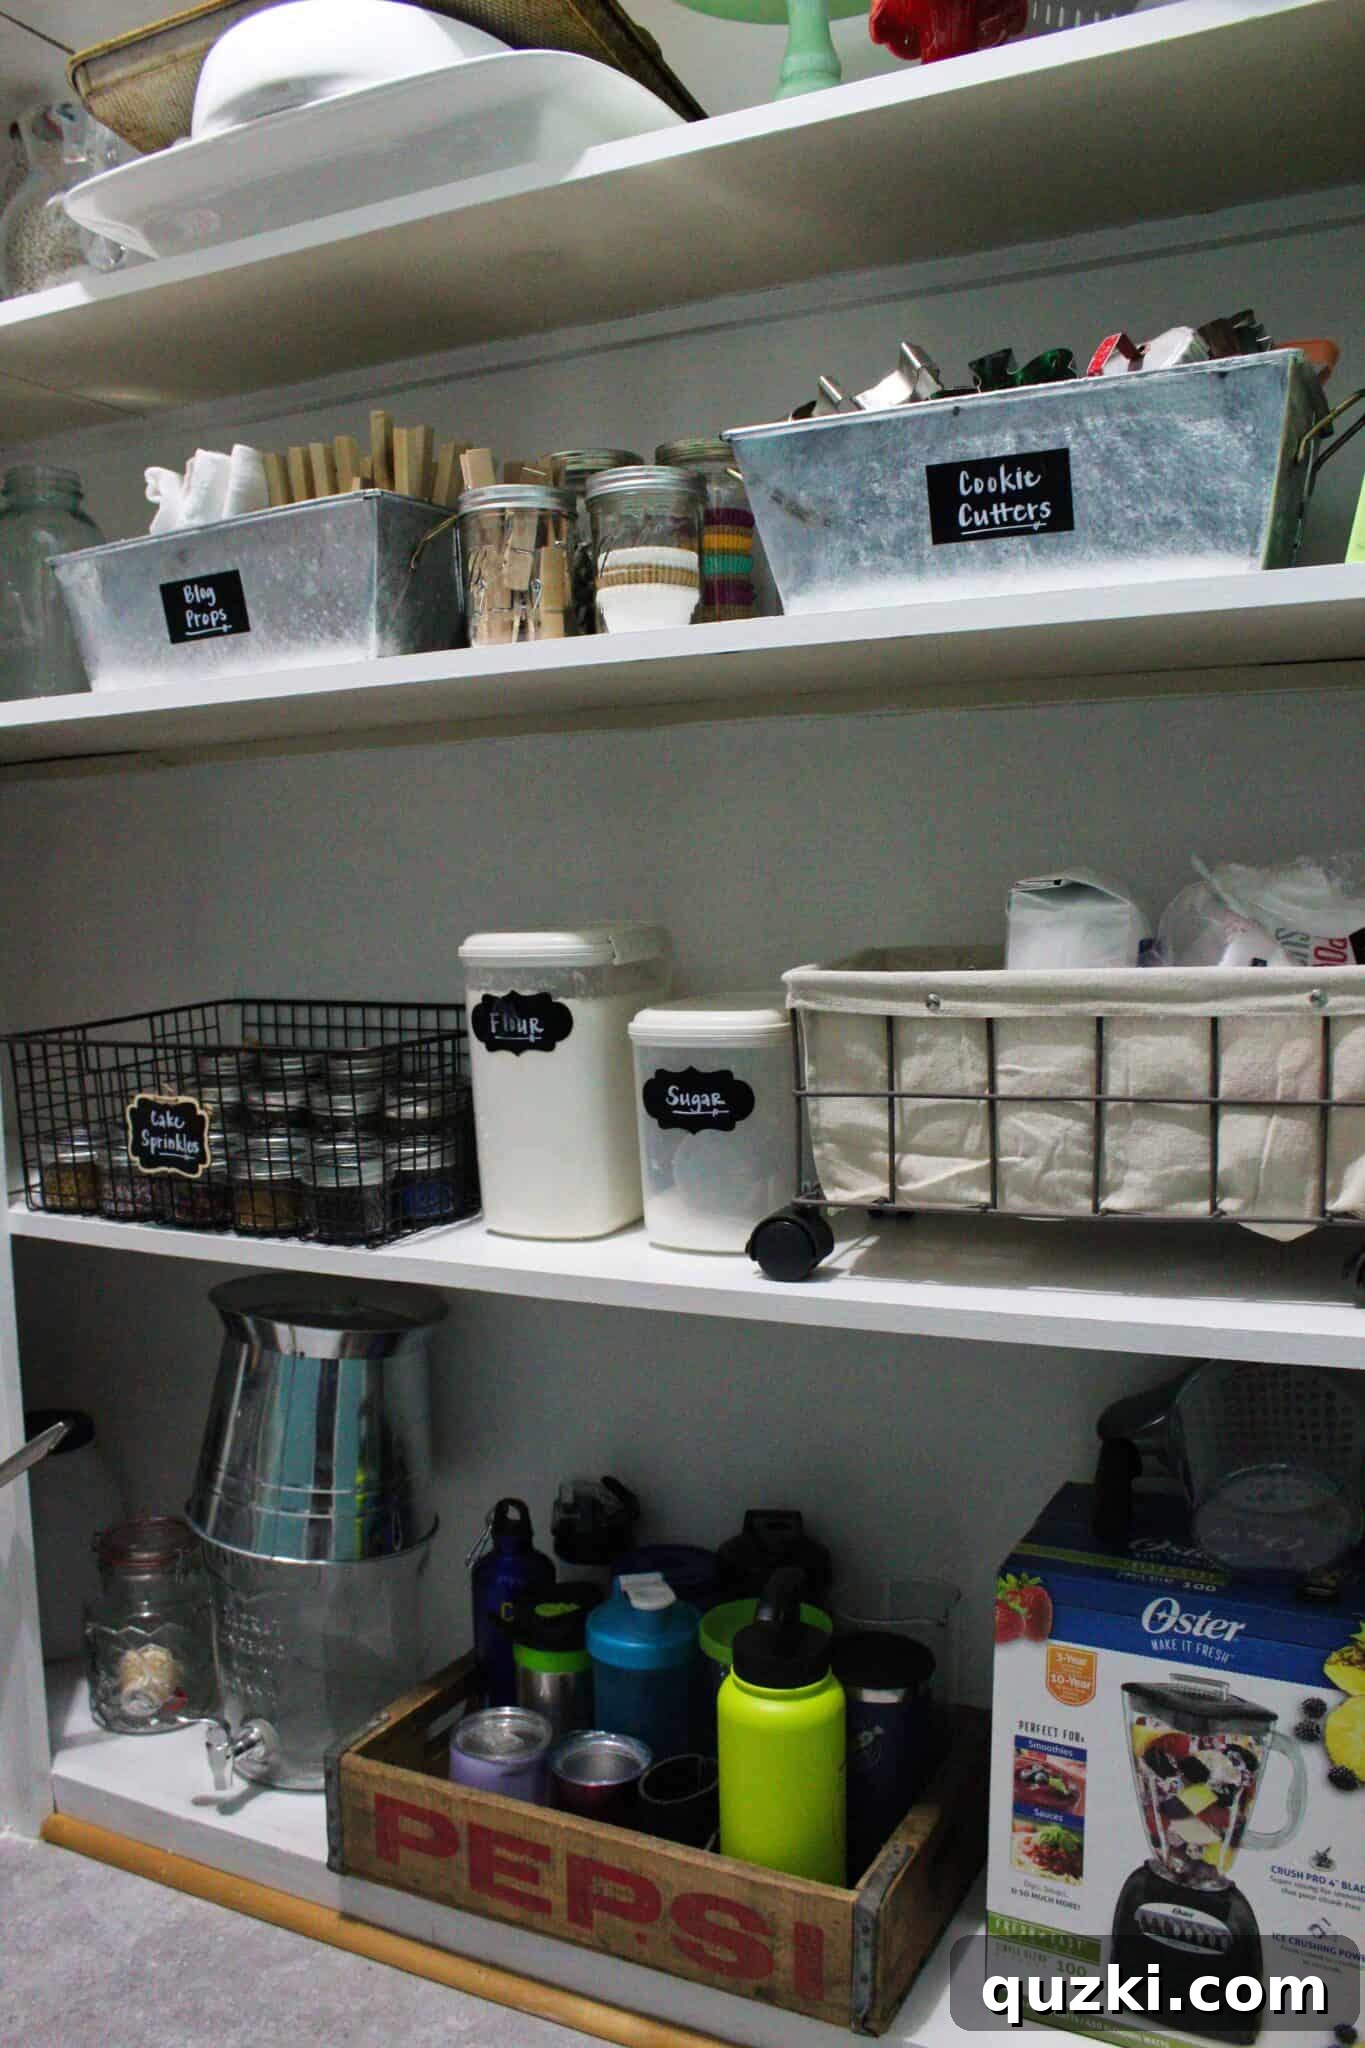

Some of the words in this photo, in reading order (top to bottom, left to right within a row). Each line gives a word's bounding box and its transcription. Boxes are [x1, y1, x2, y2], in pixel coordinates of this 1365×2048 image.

[959, 463, 1042, 496] Cookie
[958, 501, 1052, 528] Cutters
[183, 583, 216, 607] Blog
[185, 608, 227, 628] Props
[150, 1109, 185, 1129] Cake
[141, 1128, 199, 1155] Sprinkles
[1141, 1597, 1247, 1642] Oster
[1151, 1638, 1177, 1651] MAKE
[1181, 1641, 1193, 1653] IT
[1195, 1643, 1231, 1665] FRESH
[1018, 1719, 1059, 1738] PERFECT
[1270, 1864, 1304, 1881] CRUSH
[1306, 1873, 1328, 1885] PRO
[374, 1793, 825, 2002] PEPSI
[1287, 1936, 1338, 1956] CRUSHING
